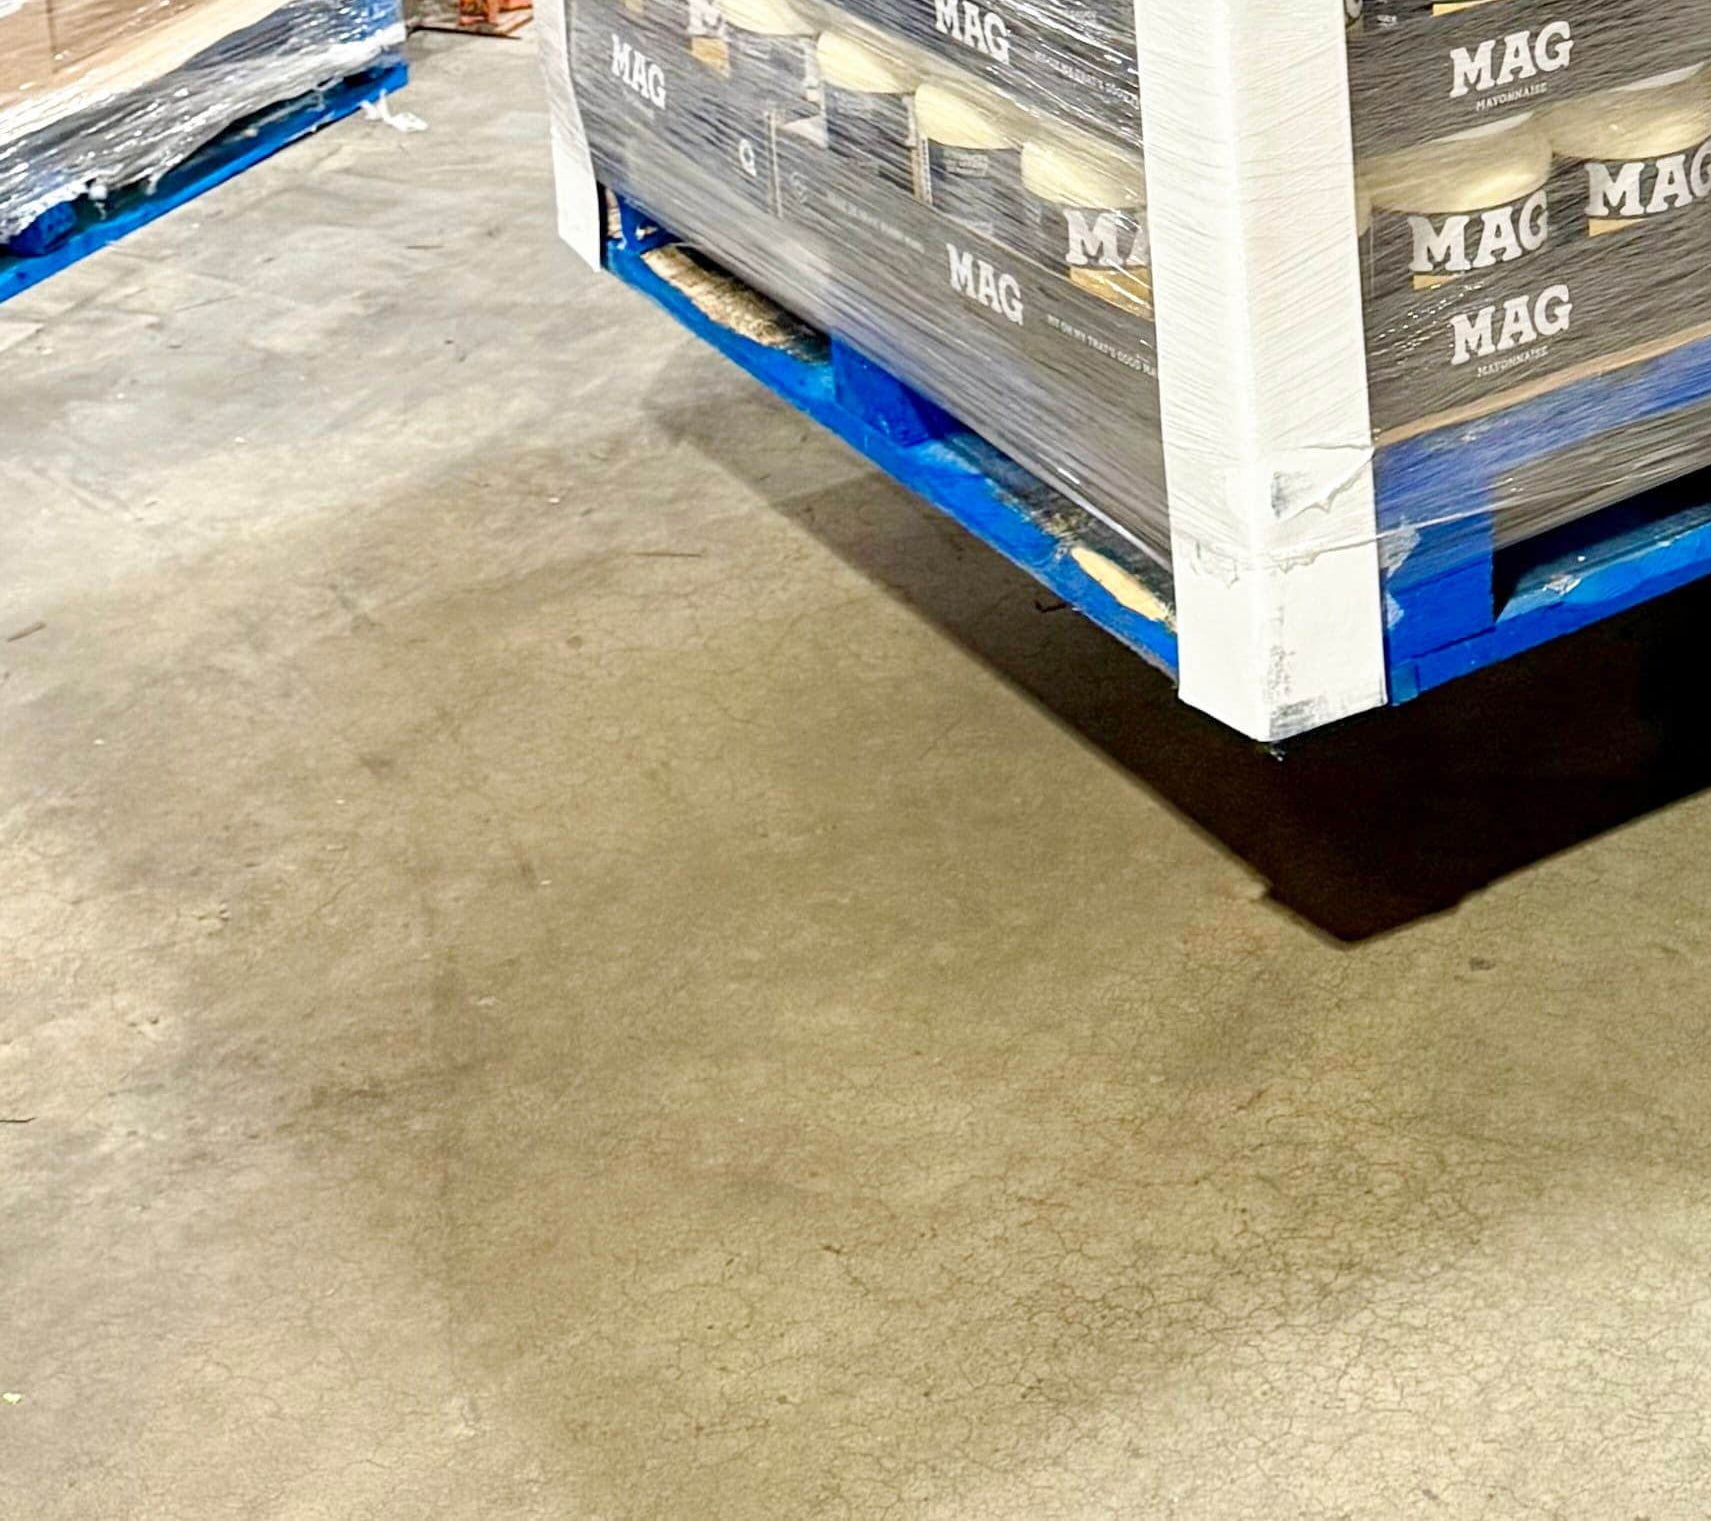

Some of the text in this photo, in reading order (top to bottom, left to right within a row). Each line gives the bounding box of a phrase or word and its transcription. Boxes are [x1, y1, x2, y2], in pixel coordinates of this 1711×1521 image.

[611, 33, 666, 110] MAG
[1450, 20, 1574, 99] MAG
[1475, 81, 1548, 112] MAYONNAISE
[1408, 189, 1548, 274] MAG
[946, 243, 1024, 326] MAG
[1450, 285, 1573, 365] MAG
